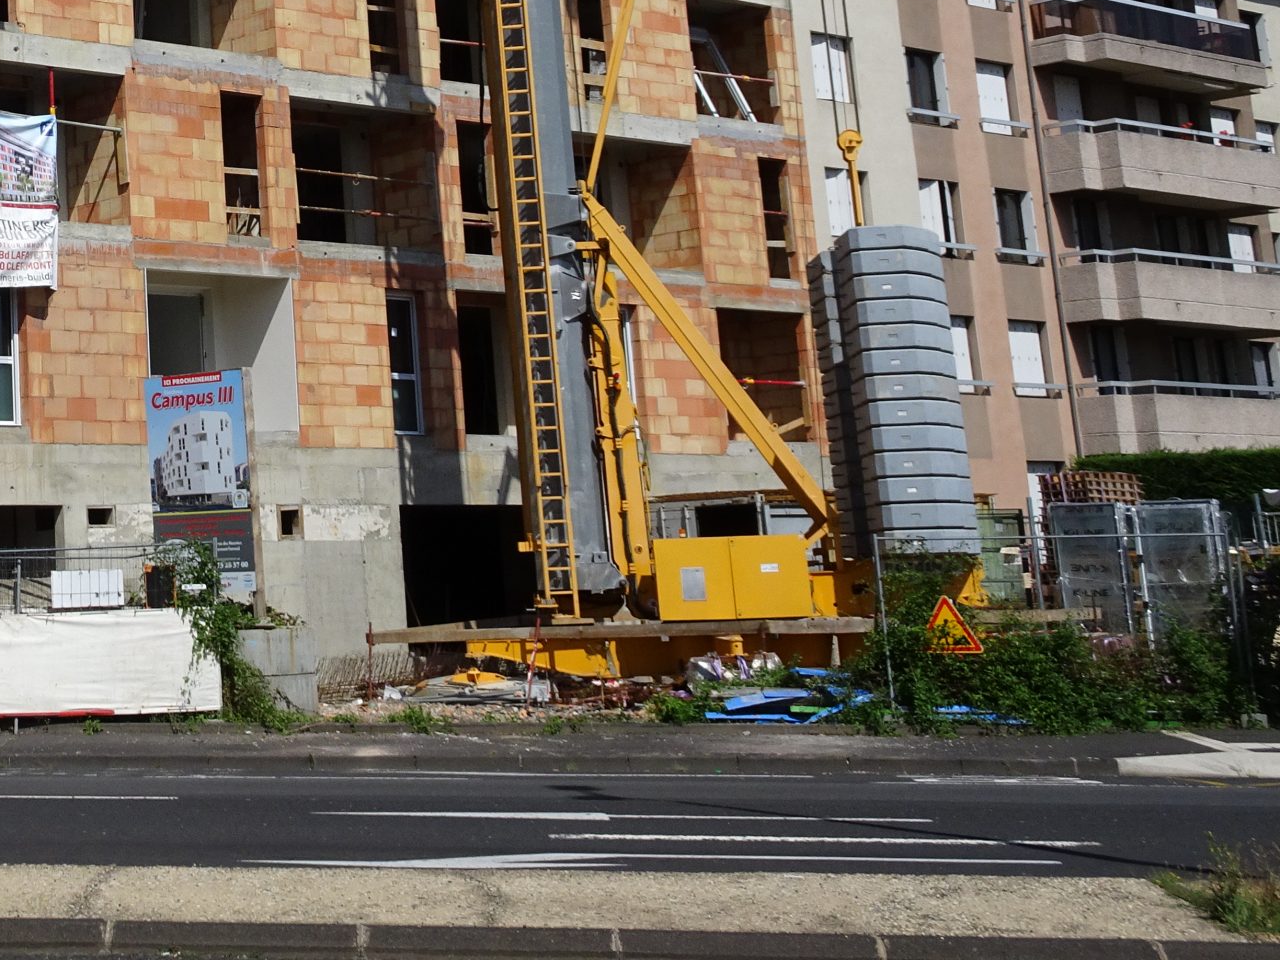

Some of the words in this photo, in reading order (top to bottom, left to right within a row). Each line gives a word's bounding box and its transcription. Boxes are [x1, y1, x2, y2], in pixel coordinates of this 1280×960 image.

[0, 250, 10, 259] Bd
[172, 375, 220, 385] PROCHAINEMENT
[151, 392, 214, 411] Campus
[218, 386, 234, 403] III
